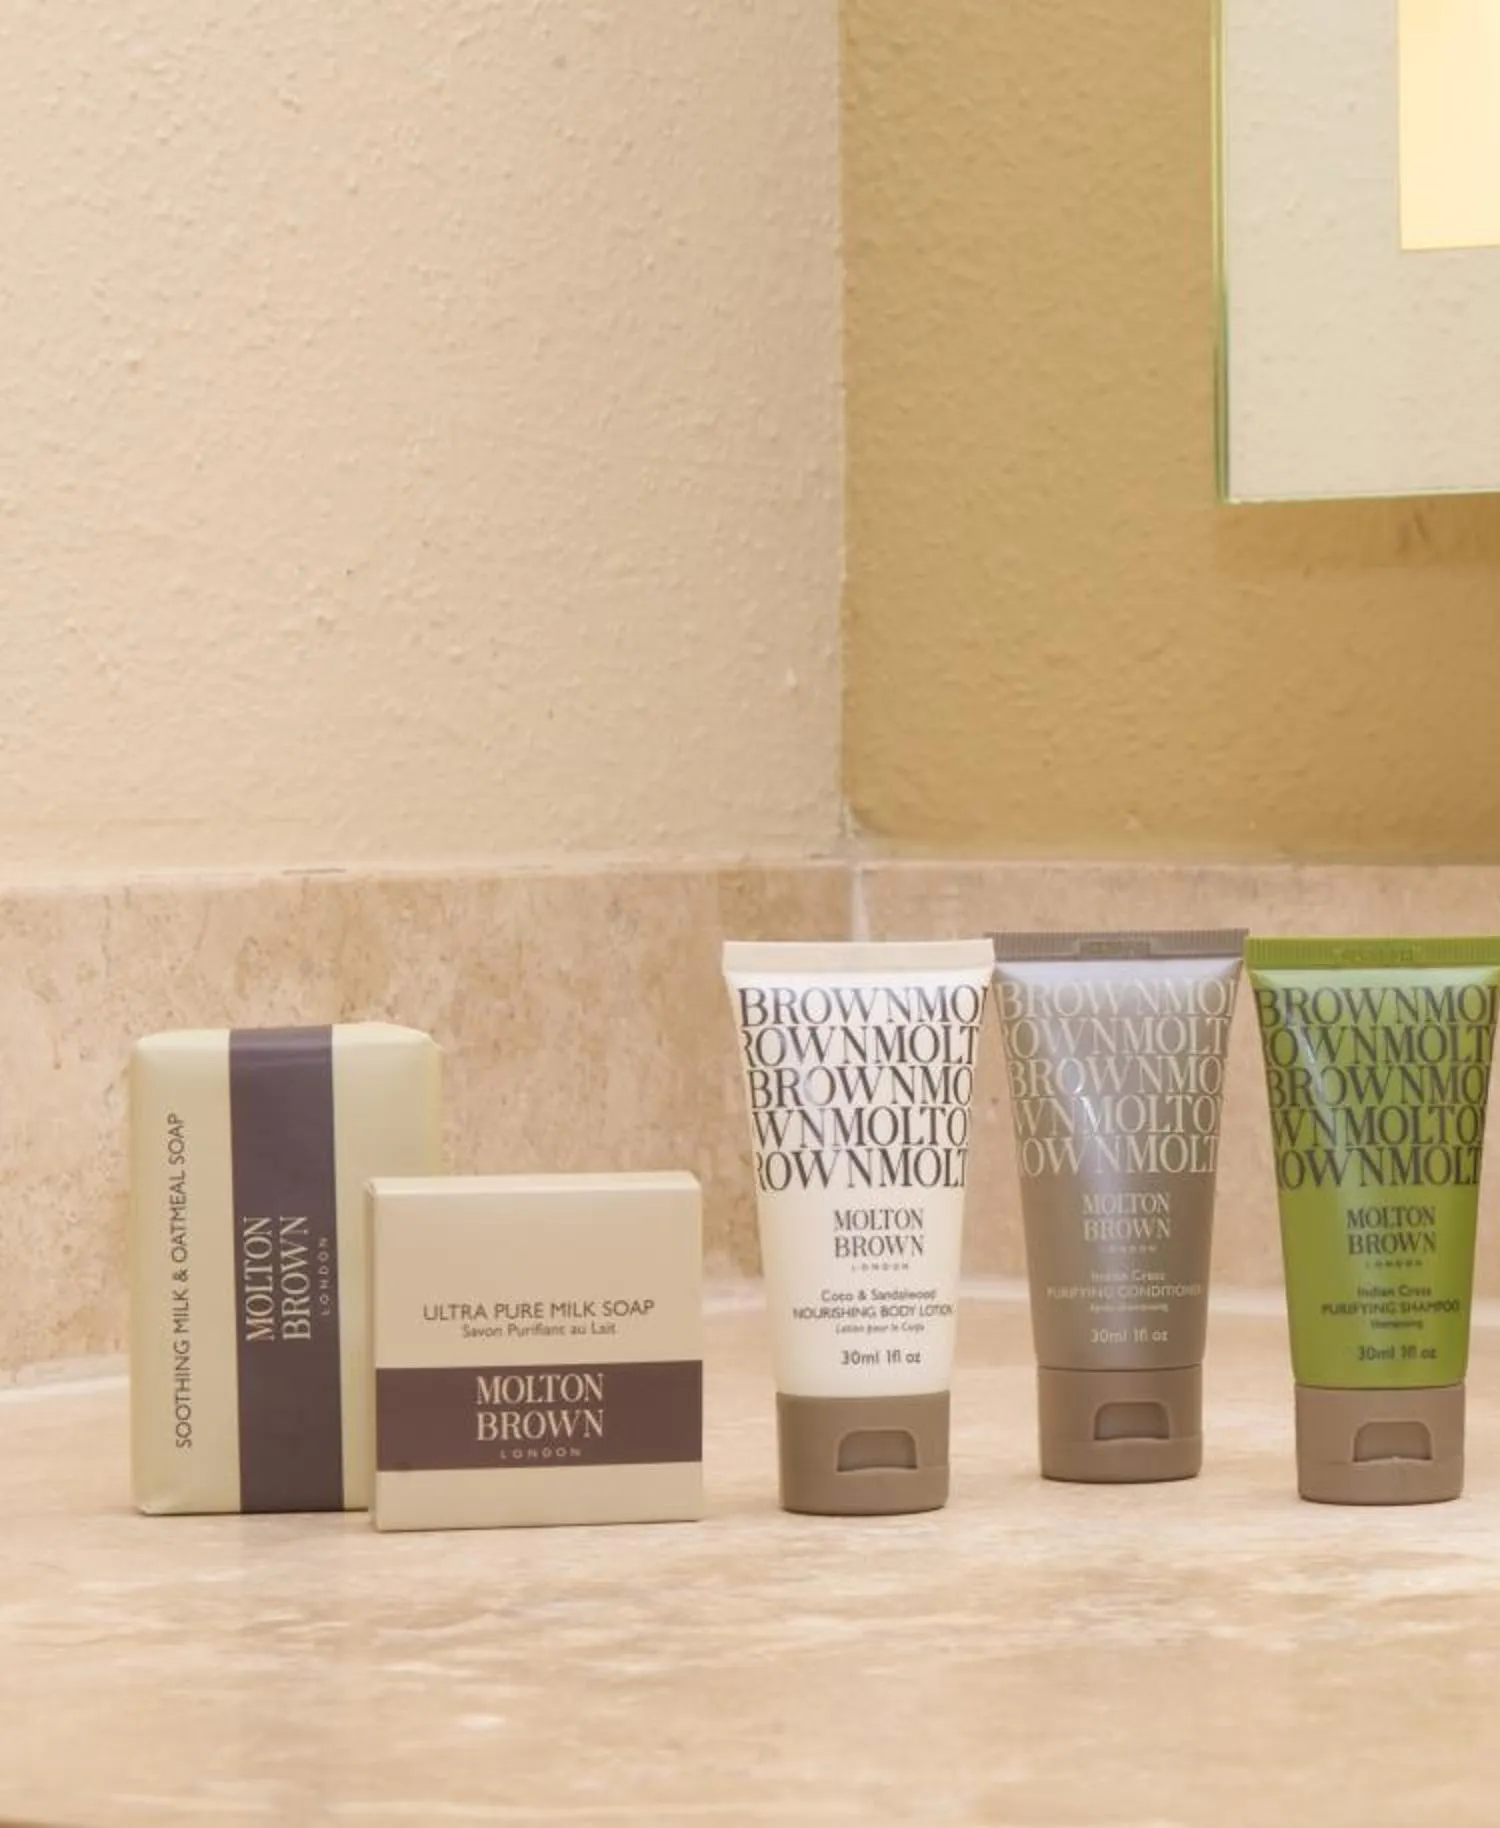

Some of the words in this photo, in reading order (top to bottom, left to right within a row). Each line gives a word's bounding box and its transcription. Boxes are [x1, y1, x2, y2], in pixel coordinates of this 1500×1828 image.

[167, 1113, 184, 1165] SOAP
[1083, 1191, 1170, 1215] MOLTON
[169, 1170, 188, 1263] OATMEAL
[834, 1208, 924, 1232] MOLTON
[1347, 1205, 1435, 1229] MOLTON
[1084, 1217, 1170, 1241] BROWN
[834, 1235, 924, 1258] BROWN
[1349, 1231, 1436, 1255] BROWN
[172, 1268, 188, 1282] &
[243, 1216, 275, 1341] MOLTON
[280, 1216, 311, 1340] BROWN
[318, 1237, 330, 1316] LONDON
[821, 1290, 853, 1302] Coco
[858, 1290, 866, 1301] &
[172, 1289, 190, 1334] MILK
[423, 1302, 488, 1320] ULTRA
[494, 1301, 544, 1320] PURE
[551, 1300, 596, 1318] MILK
[602, 1299, 655, 1317] SOAP
[793, 1306, 877, 1320] NOURISHING
[880, 1305, 915, 1318] BODY
[462, 1324, 503, 1338] Savon
[508, 1323, 566, 1338] Purifiant
[570, 1325, 586, 1336] au
[591, 1321, 616, 1335] Lait
[1090, 1328, 1127, 1343] 30ml
[841, 1350, 879, 1365] 30ml
[905, 1352, 921, 1364] oz
[1359, 1345, 1395, 1361] 30ml
[173, 1340, 192, 1448] SOOTHING
[476, 1372, 604, 1405] MOLTON
[476, 1409, 604, 1441] BROWN
[500, 1447, 581, 1459] LONDON
